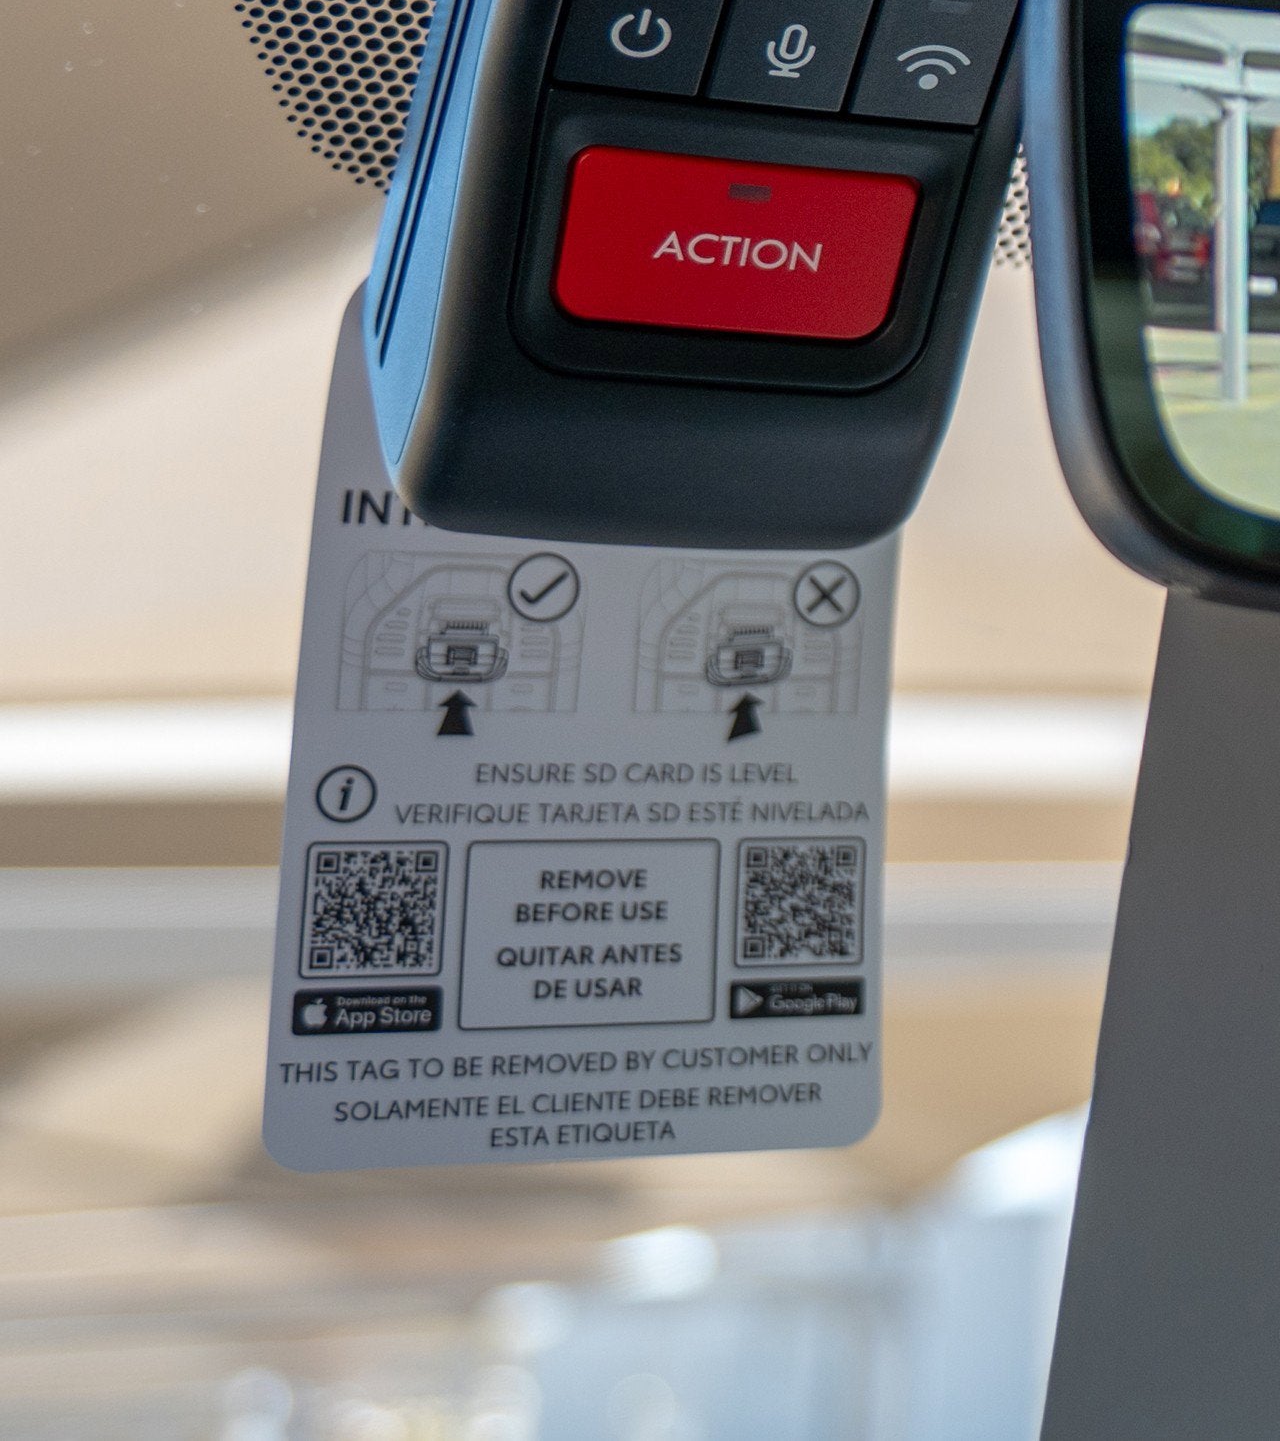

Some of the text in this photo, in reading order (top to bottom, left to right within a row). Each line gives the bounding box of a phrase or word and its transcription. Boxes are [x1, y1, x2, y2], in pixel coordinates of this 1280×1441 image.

[653, 230, 823, 272] ACTION
[476, 762, 799, 785] ENSURE SD CARD IS LEVEL
[396, 802, 531, 825] VERIFIQUE
[538, 801, 641, 824] TARJETA
[648, 801, 681, 823] SD
[752, 801, 870, 823] NIVELADA
[540, 869, 648, 891] REMOVE
[515, 900, 669, 924] BEFORE USE
[496, 943, 684, 967] QUITAR ANTES
[336, 994, 428, 1007] Download on the
[534, 977, 643, 1000] DE USAR
[335, 1006, 432, 1030] App Store
[279, 1041, 873, 1084] THIS TAG TO BE REMOVED BY CUSTOMER ONLY
[334, 1081, 823, 1123] SOLAMENTE EL CLIENTE DEBE REMOVER
[490, 1120, 677, 1149] ESTA ETIQUETA
